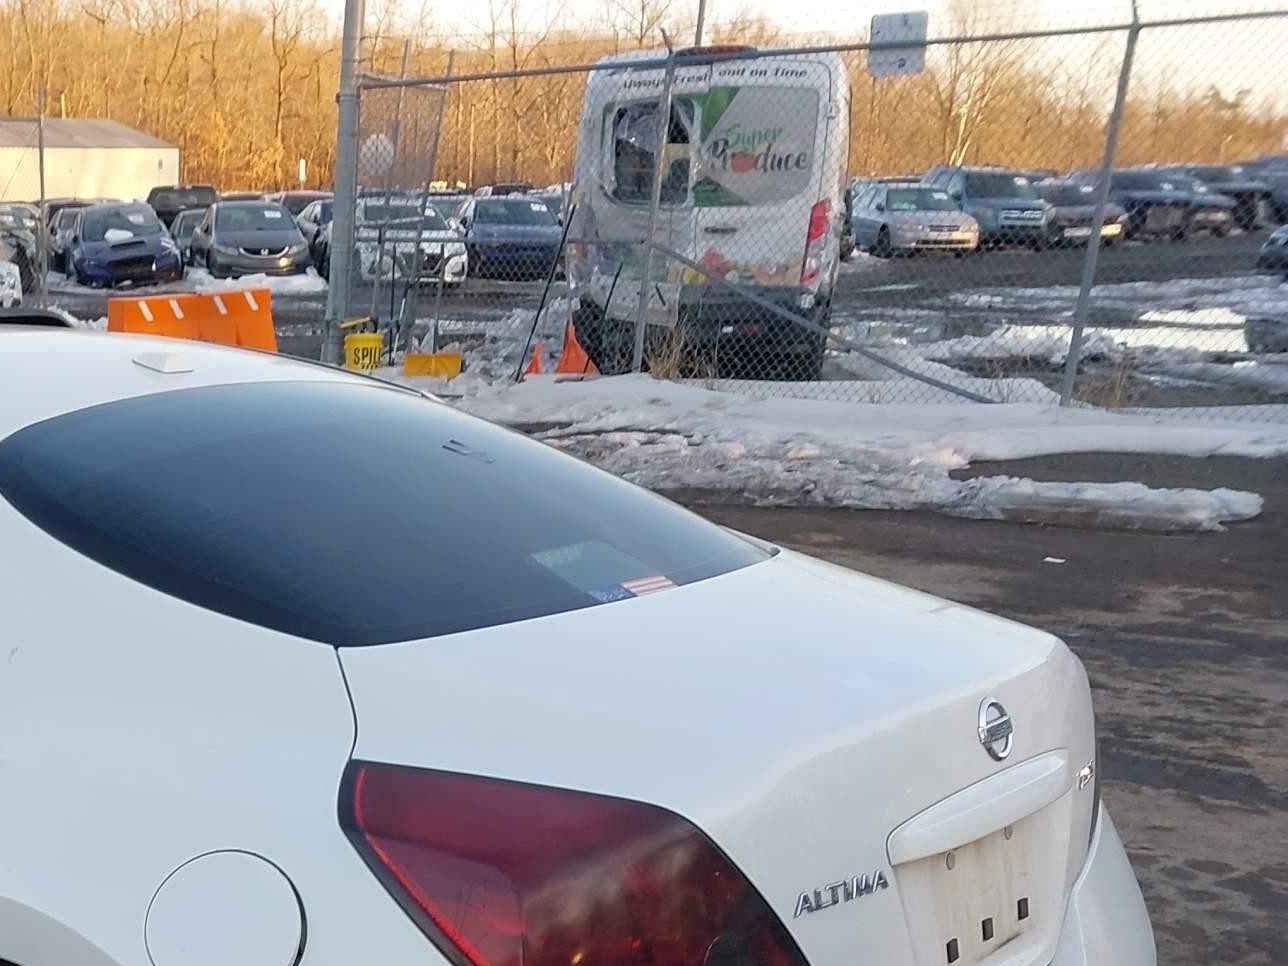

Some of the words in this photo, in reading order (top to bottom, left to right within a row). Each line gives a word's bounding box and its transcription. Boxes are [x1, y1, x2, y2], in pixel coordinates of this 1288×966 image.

[718, 66, 745, 77] and
[749, 68, 767, 77] on
[774, 66, 808, 78] Time
[727, 122, 783, 152] Super
[794, 868, 889, 918] ALTIMA
